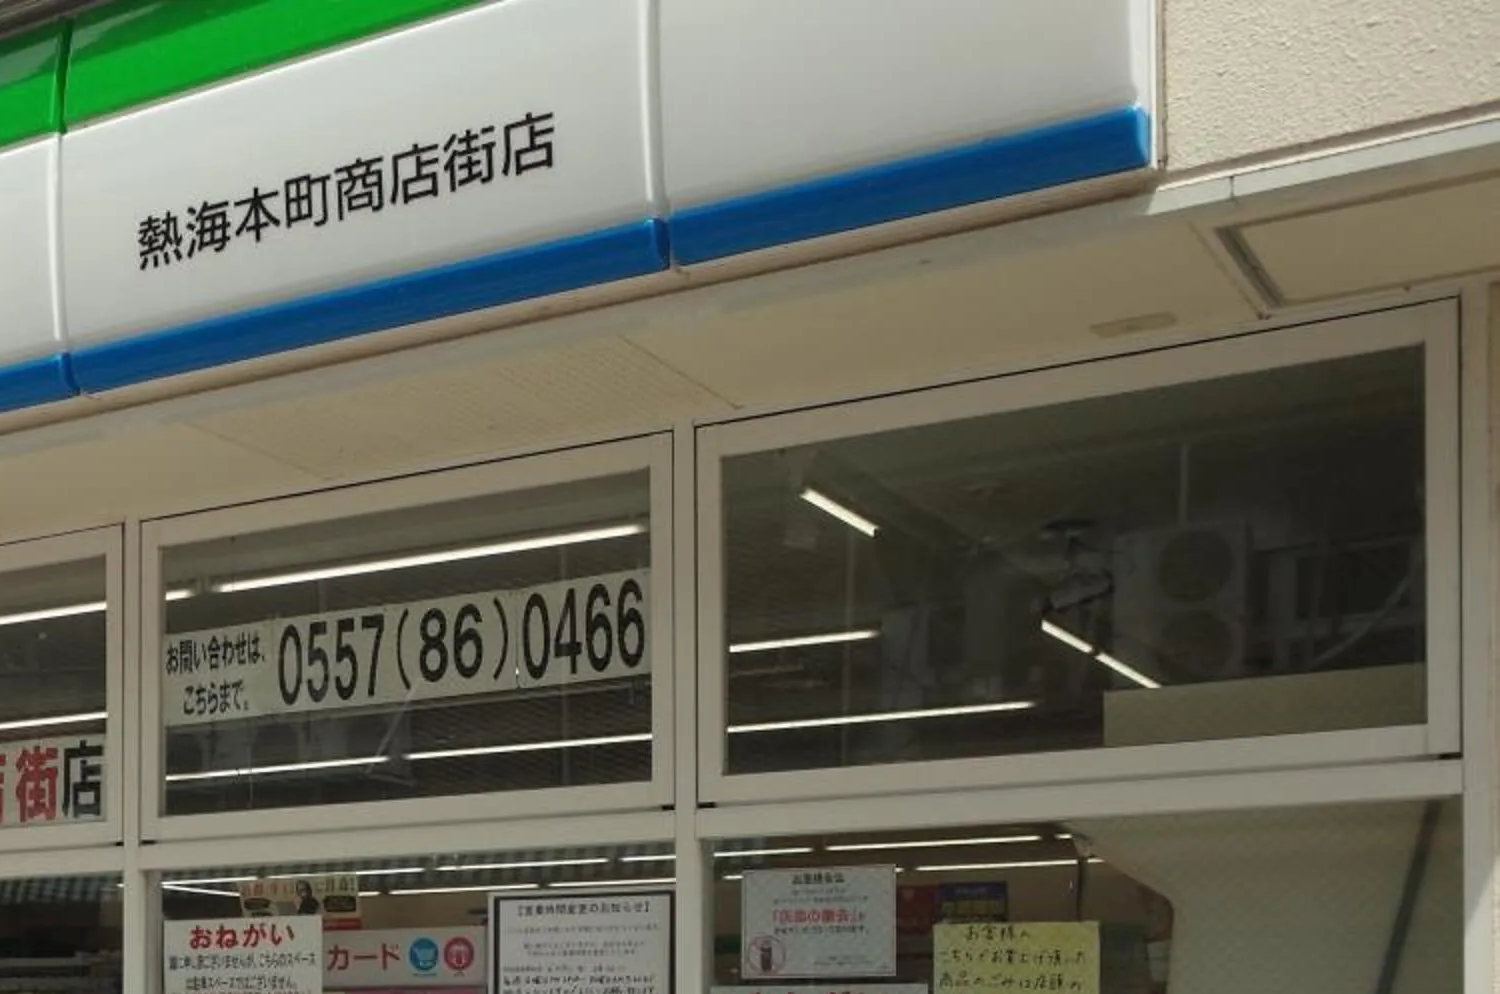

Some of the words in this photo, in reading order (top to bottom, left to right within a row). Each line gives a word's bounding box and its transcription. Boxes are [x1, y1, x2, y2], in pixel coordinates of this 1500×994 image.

[138, 112, 554, 270] 熱海本町商店街店
[189, 922, 296, 950] おねがい
